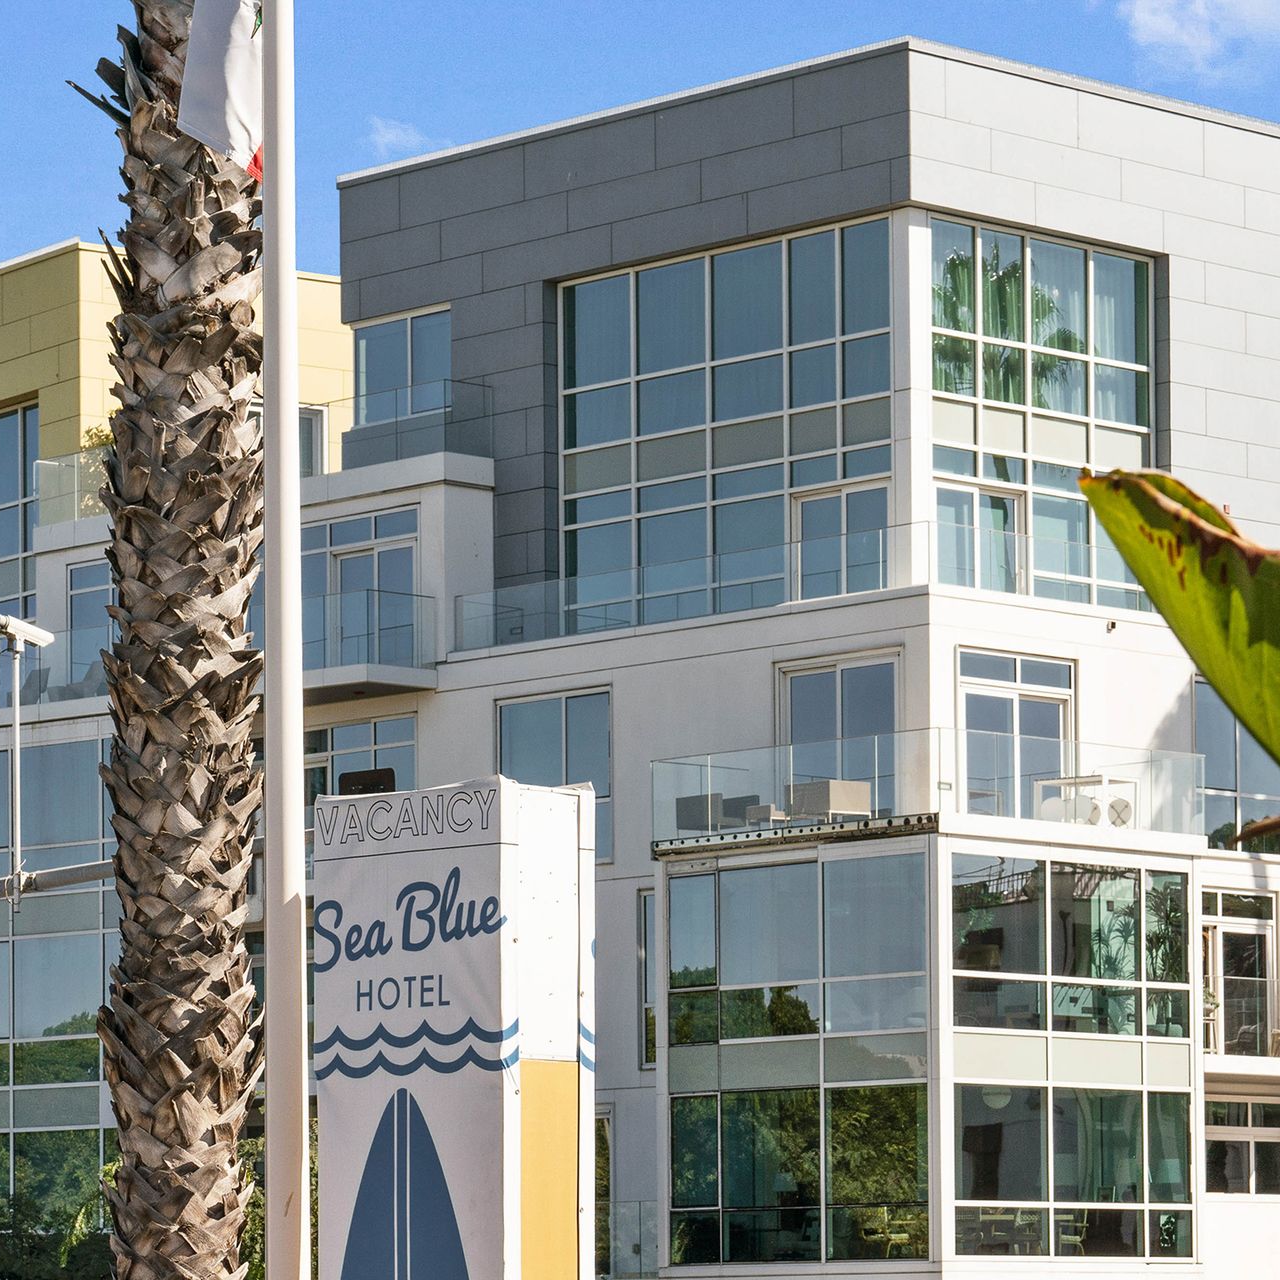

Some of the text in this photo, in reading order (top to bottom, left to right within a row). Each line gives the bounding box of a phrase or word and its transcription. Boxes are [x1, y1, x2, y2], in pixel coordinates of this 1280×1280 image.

[317, 788, 497, 846] VACANCY
[314, 866, 508, 973] Sea Blue
[355, 974, 451, 1013] HOTEL
